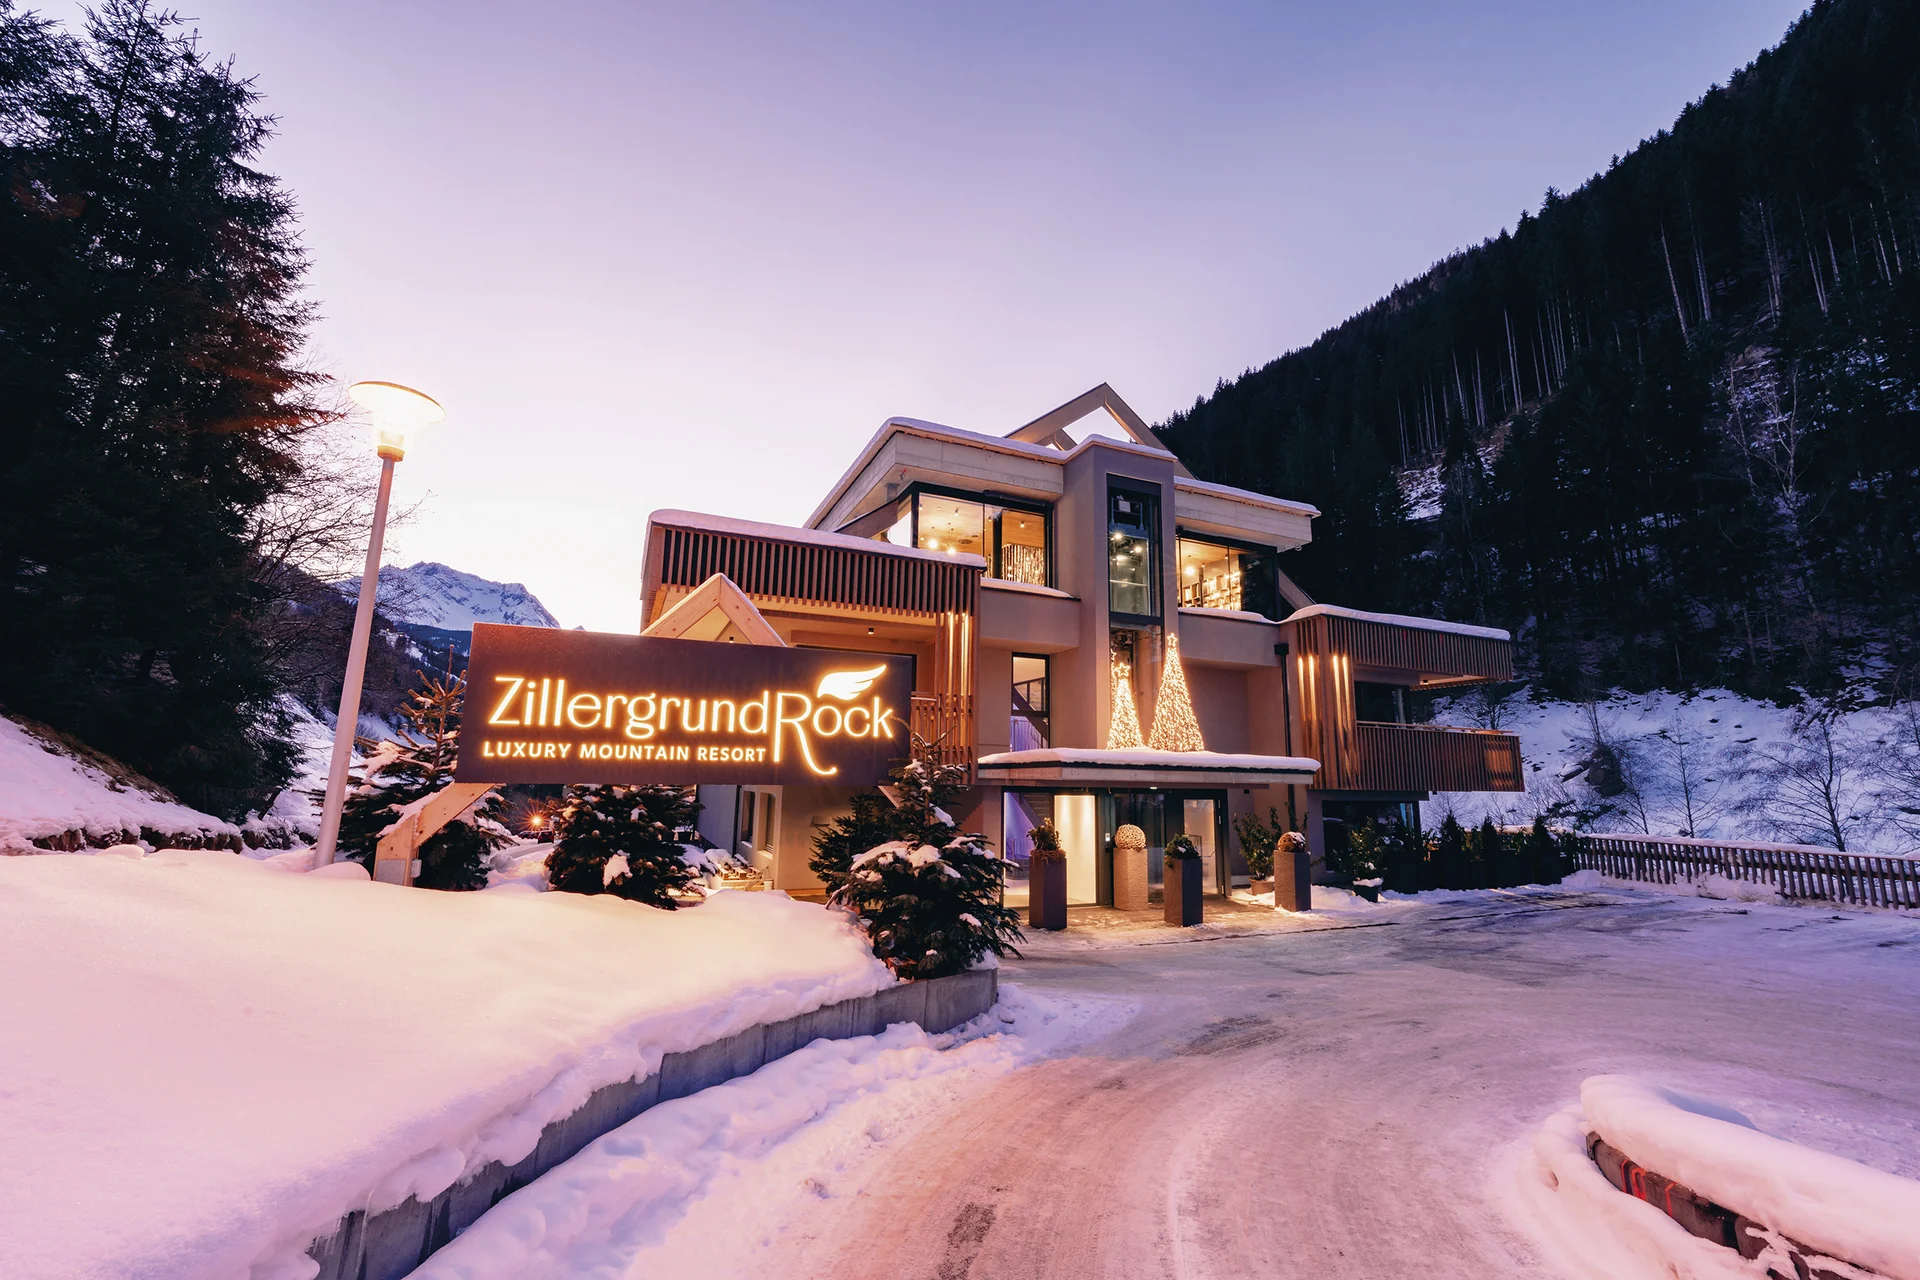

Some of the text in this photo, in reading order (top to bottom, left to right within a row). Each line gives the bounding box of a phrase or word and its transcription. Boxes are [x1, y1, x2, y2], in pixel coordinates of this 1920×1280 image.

[483, 741, 767, 762] LUXURY MOUNTAIN RESORT
